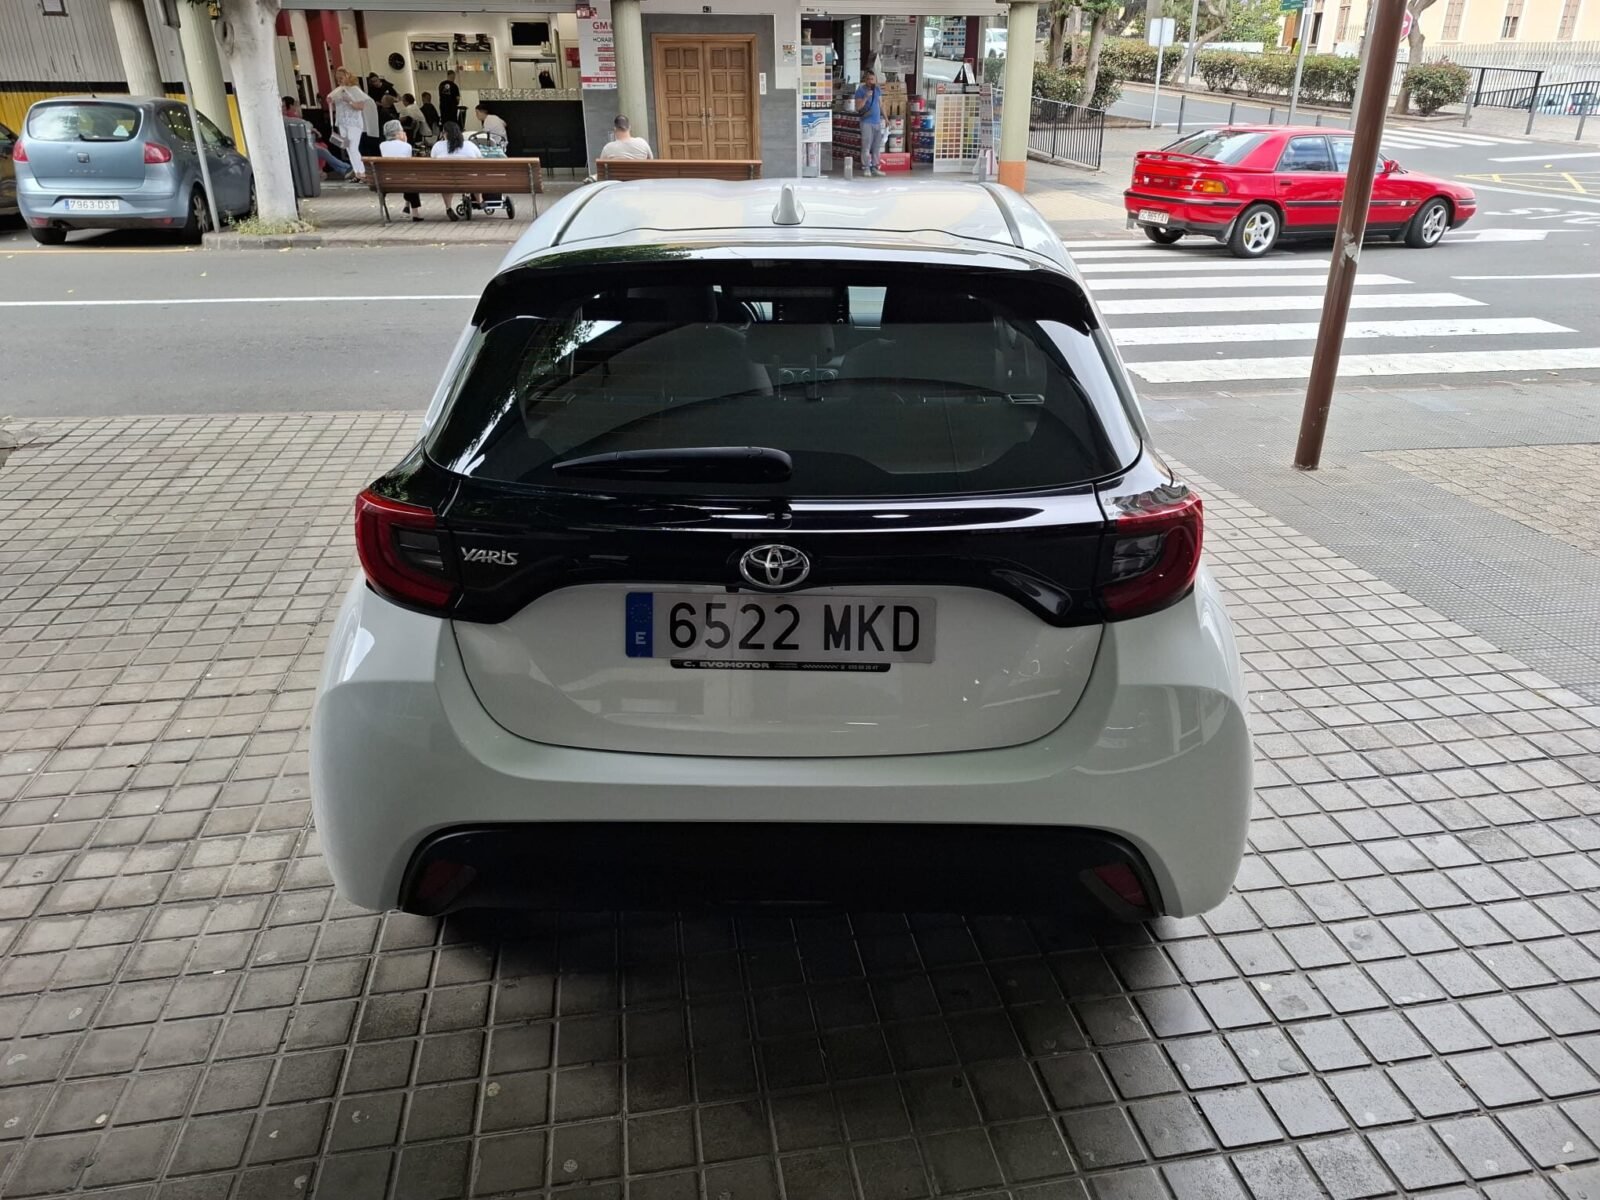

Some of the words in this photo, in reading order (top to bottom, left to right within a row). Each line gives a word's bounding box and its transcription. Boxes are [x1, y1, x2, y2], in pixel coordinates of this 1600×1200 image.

[592, 21, 608, 30] GM
[70, 200, 95, 209] 7963
[97, 200, 116, 209] DST
[460, 546, 520, 566] YARIS
[669, 602, 800, 650] 6522
[823, 604, 920, 652] MKD
[635, 631, 647, 645] E
[699, 661, 770, 669] EVOMOTOR
